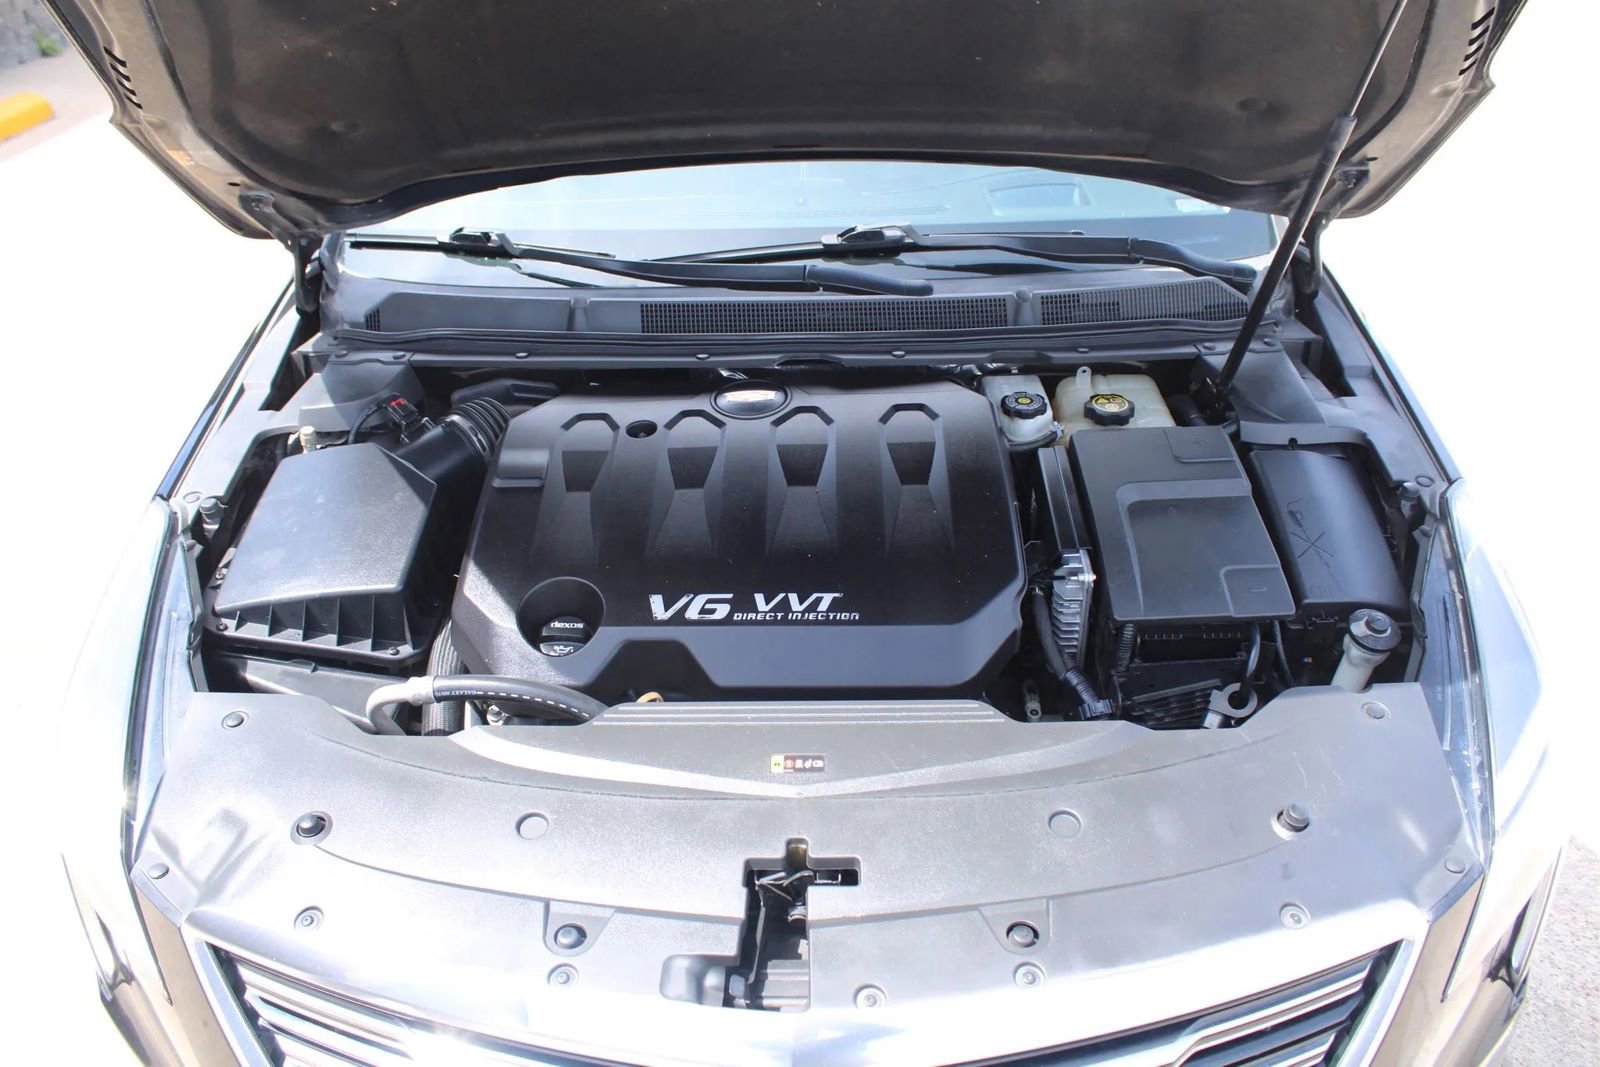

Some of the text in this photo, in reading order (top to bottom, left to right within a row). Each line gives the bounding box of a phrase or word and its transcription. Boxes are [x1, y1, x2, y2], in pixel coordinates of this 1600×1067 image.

[649, 592, 843, 621] V6 VVT
[733, 612, 859, 621] DIRECT INJECTION
[550, 620, 585, 629] dexos
